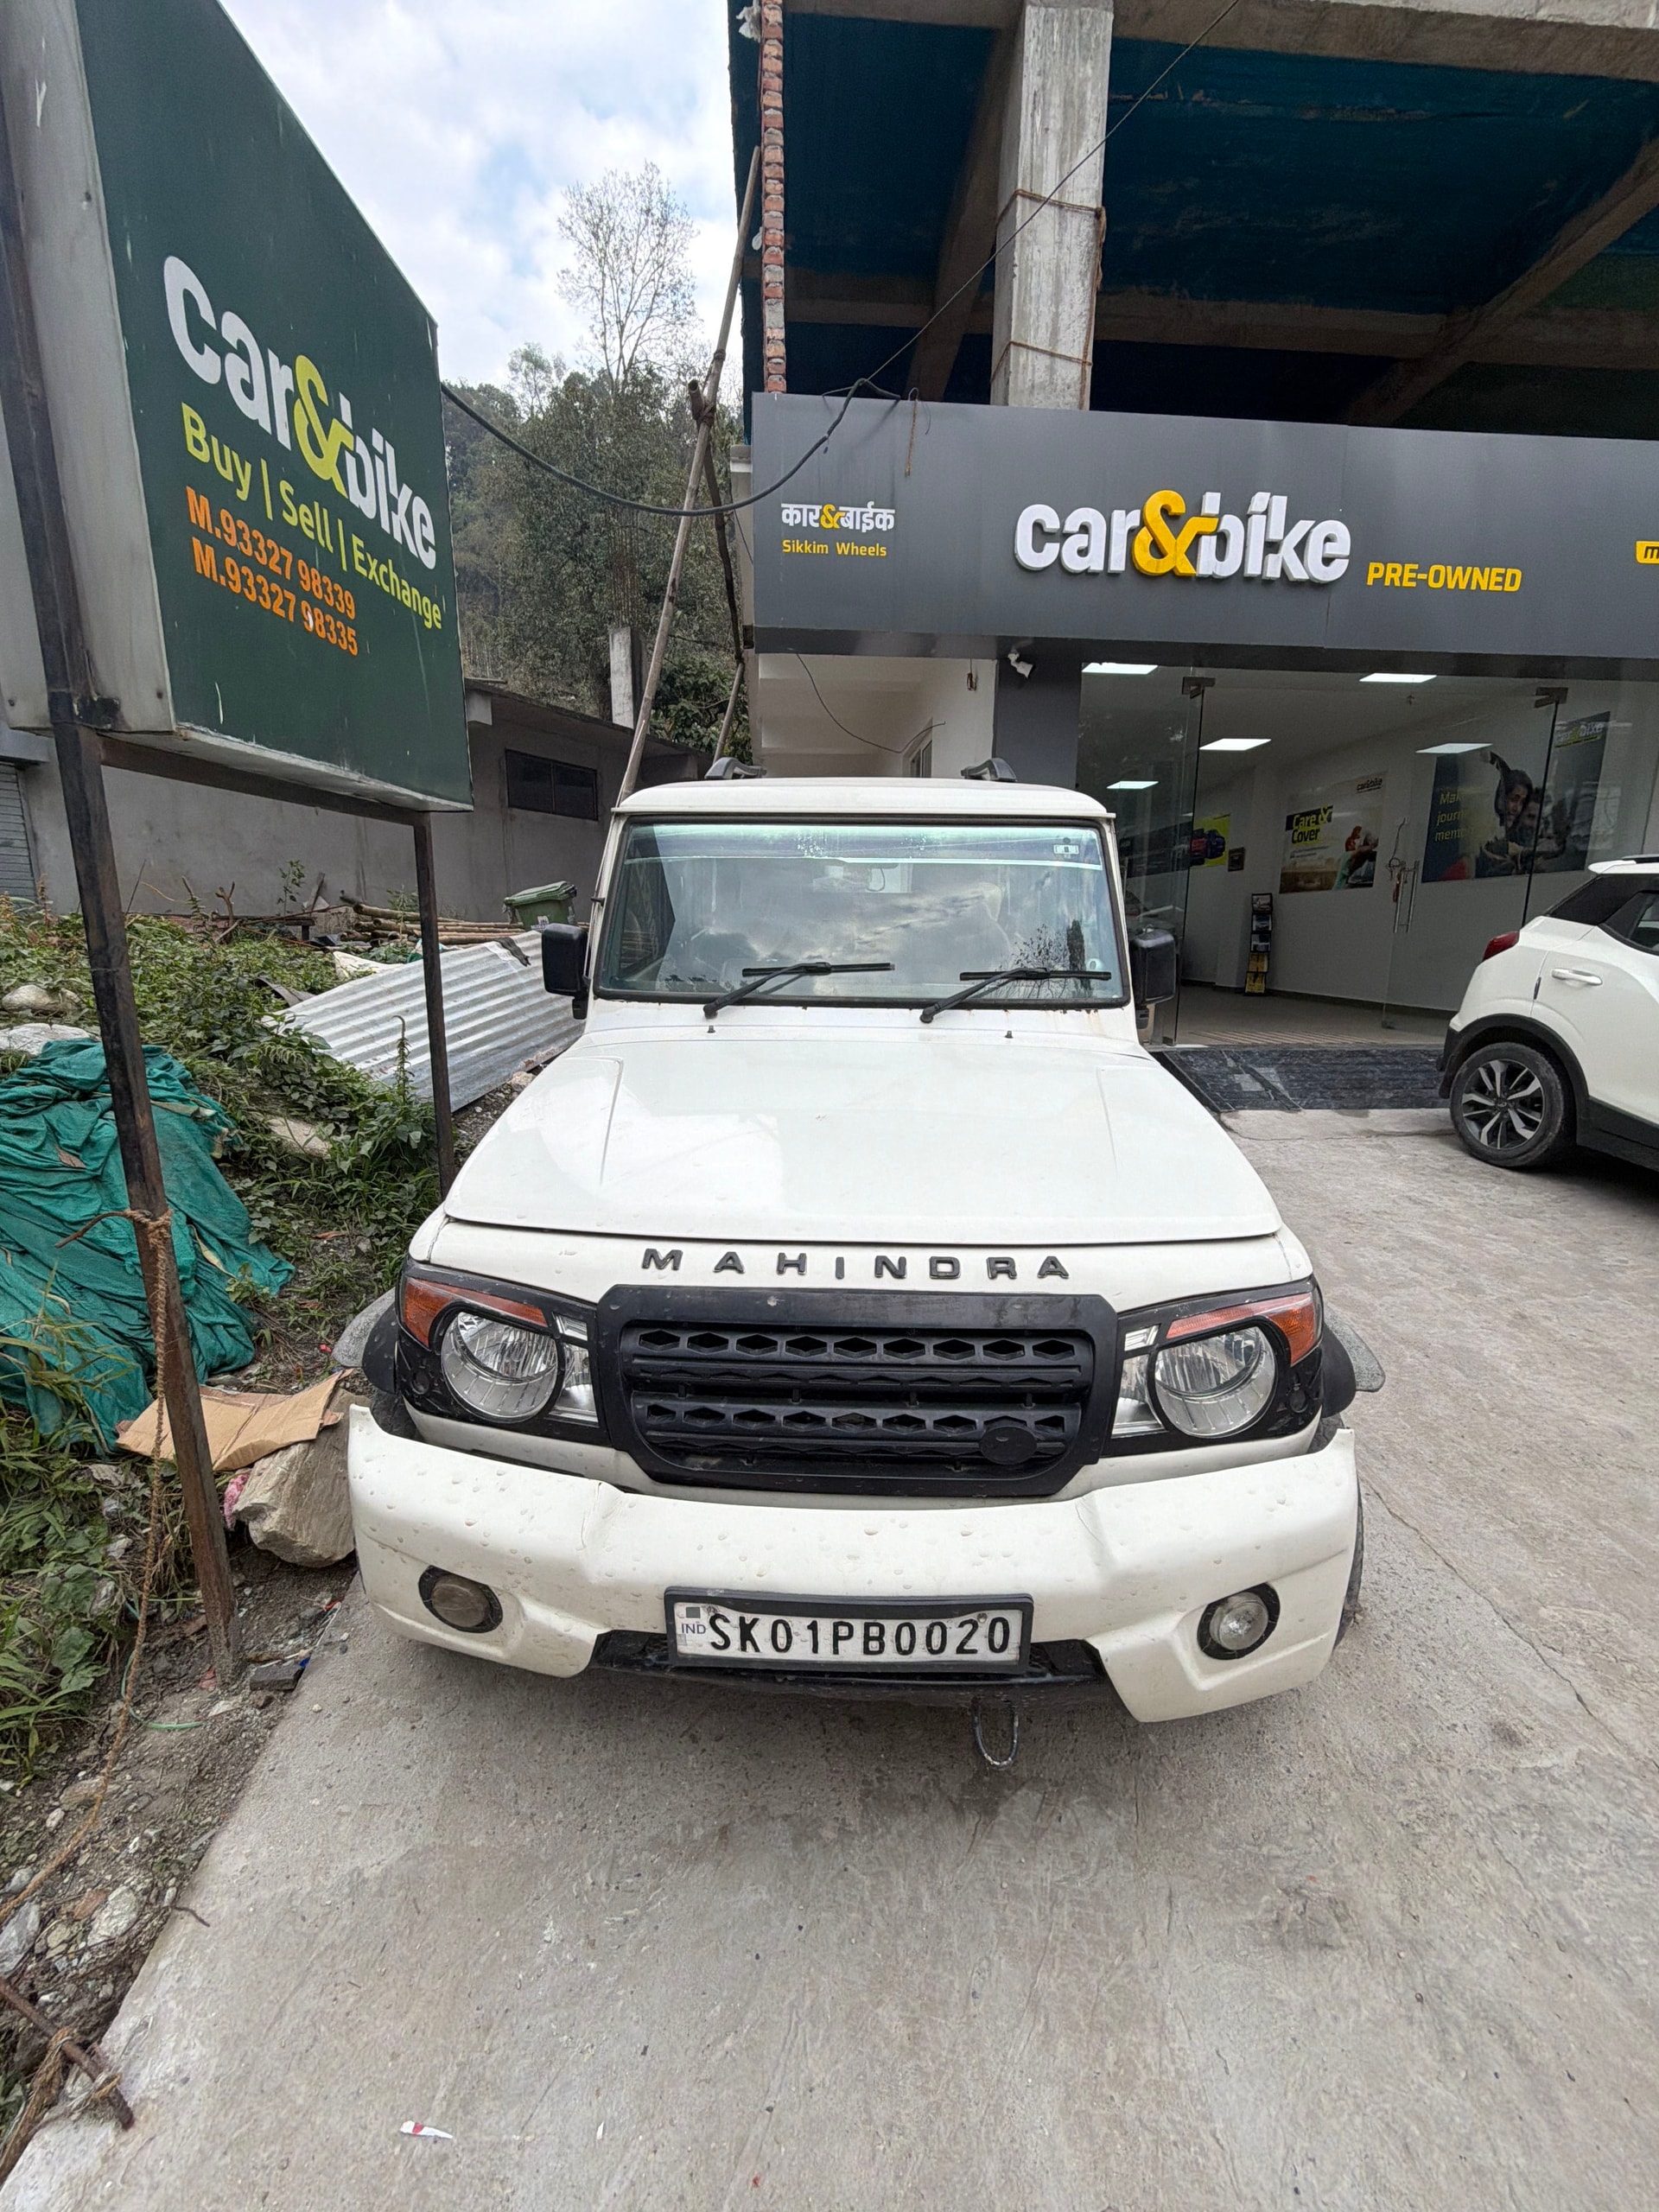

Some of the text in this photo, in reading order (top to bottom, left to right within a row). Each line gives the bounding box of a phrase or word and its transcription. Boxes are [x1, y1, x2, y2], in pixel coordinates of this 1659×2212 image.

[164, 256, 435, 569] car&bike
[181, 403, 251, 501] Buy
[280, 480, 334, 553] Sell
[353, 533, 442, 629] Exchange
[1014, 489, 1351, 585] car&bike
[186, 486, 355, 620] M.93327 98339
[782, 539, 887, 556] Sikkim Wheels
[192, 537, 358, 657] M.93327 98335
[1366, 562, 1522, 593] PRE-OWNED
[1292, 828, 1320, 844] Cover
[1293, 814, 1316, 830] Care
[641, 1248, 1070, 1279] MAHINDRA
[681, 1612, 1010, 1656] IND SK01PB0020
